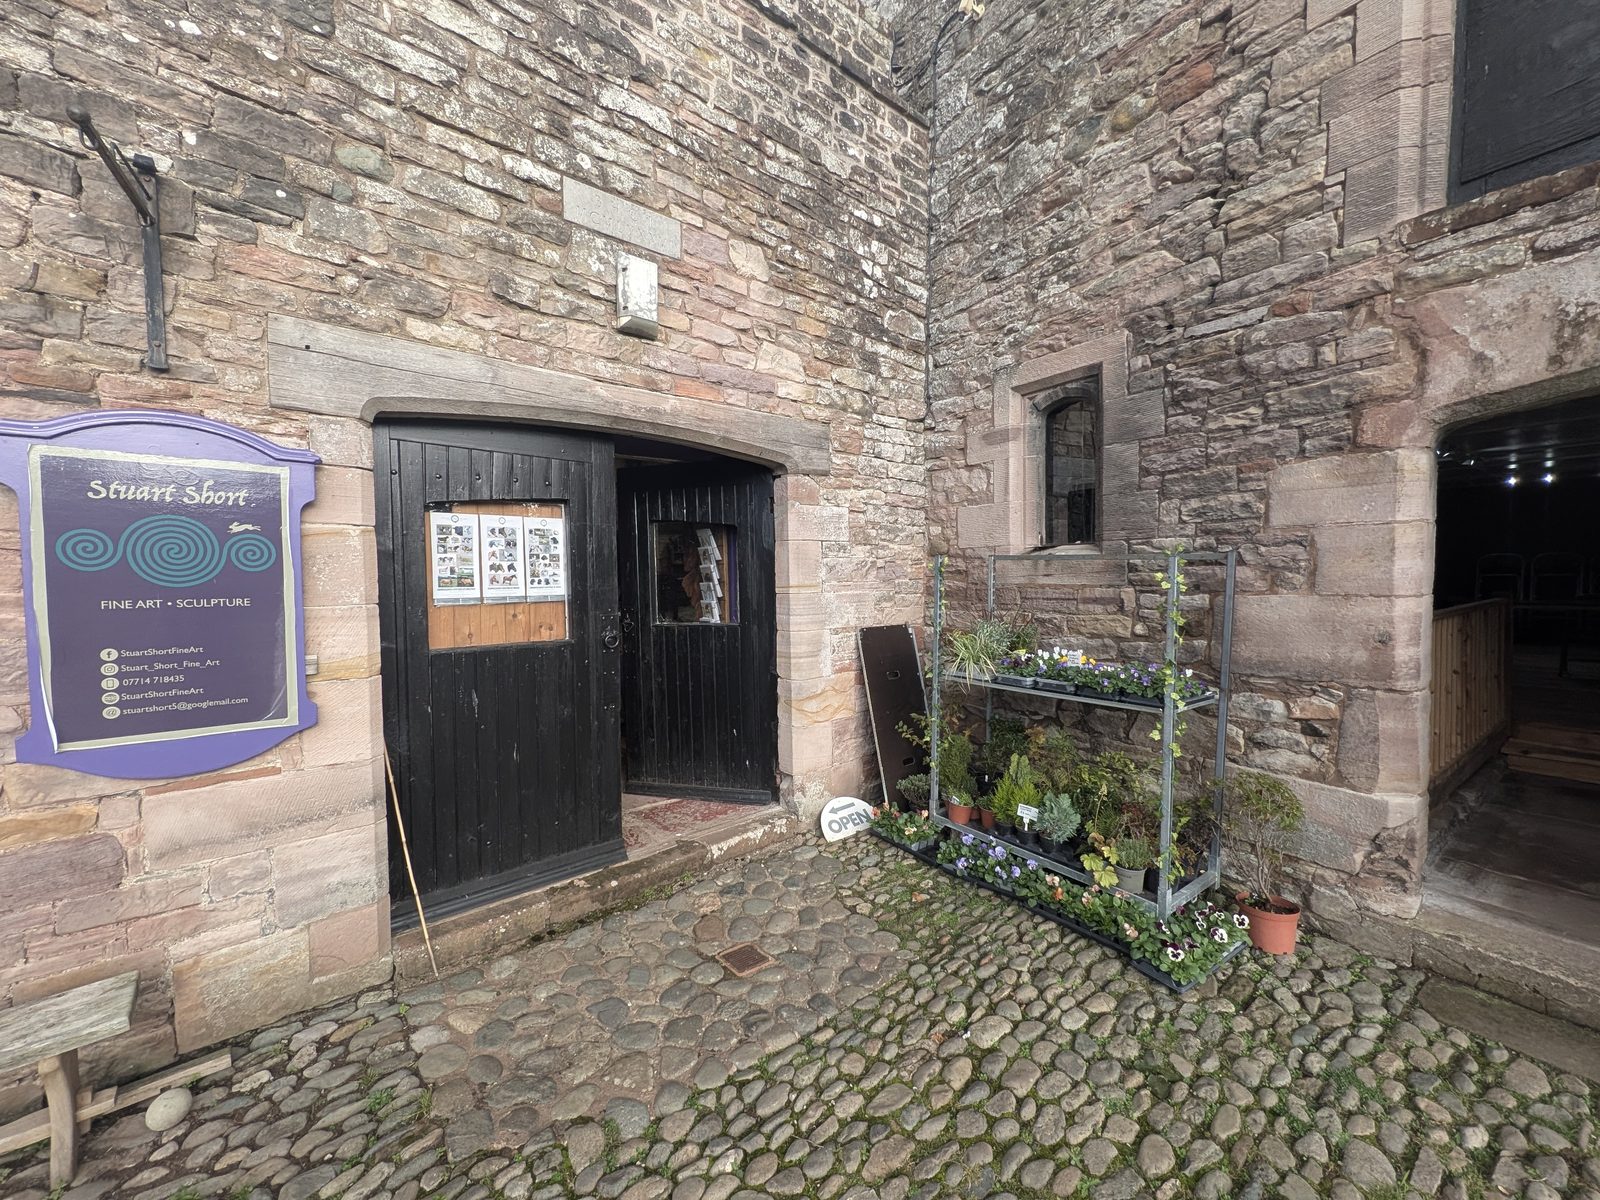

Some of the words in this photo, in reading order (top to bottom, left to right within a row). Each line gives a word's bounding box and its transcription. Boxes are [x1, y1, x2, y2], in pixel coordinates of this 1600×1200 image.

[87, 480, 176, 502] Stuart
[182, 479, 250, 506] Short
[101, 600, 133, 610] FINE
[135, 599, 163, 609] ART
[176, 598, 251, 608] SCULPTURE
[120, 646, 204, 658] StuartShortFineArt
[121, 659, 220, 672] Stuart_Short_Fine_Art
[122, 677, 151, 686] 07714
[153, 675, 185, 684] 718435
[121, 687, 204, 701] StuartShortFineArt
[122, 697, 249, 715] stuartshort5@googlemail.com
[828, 808, 872, 834] OPEN
